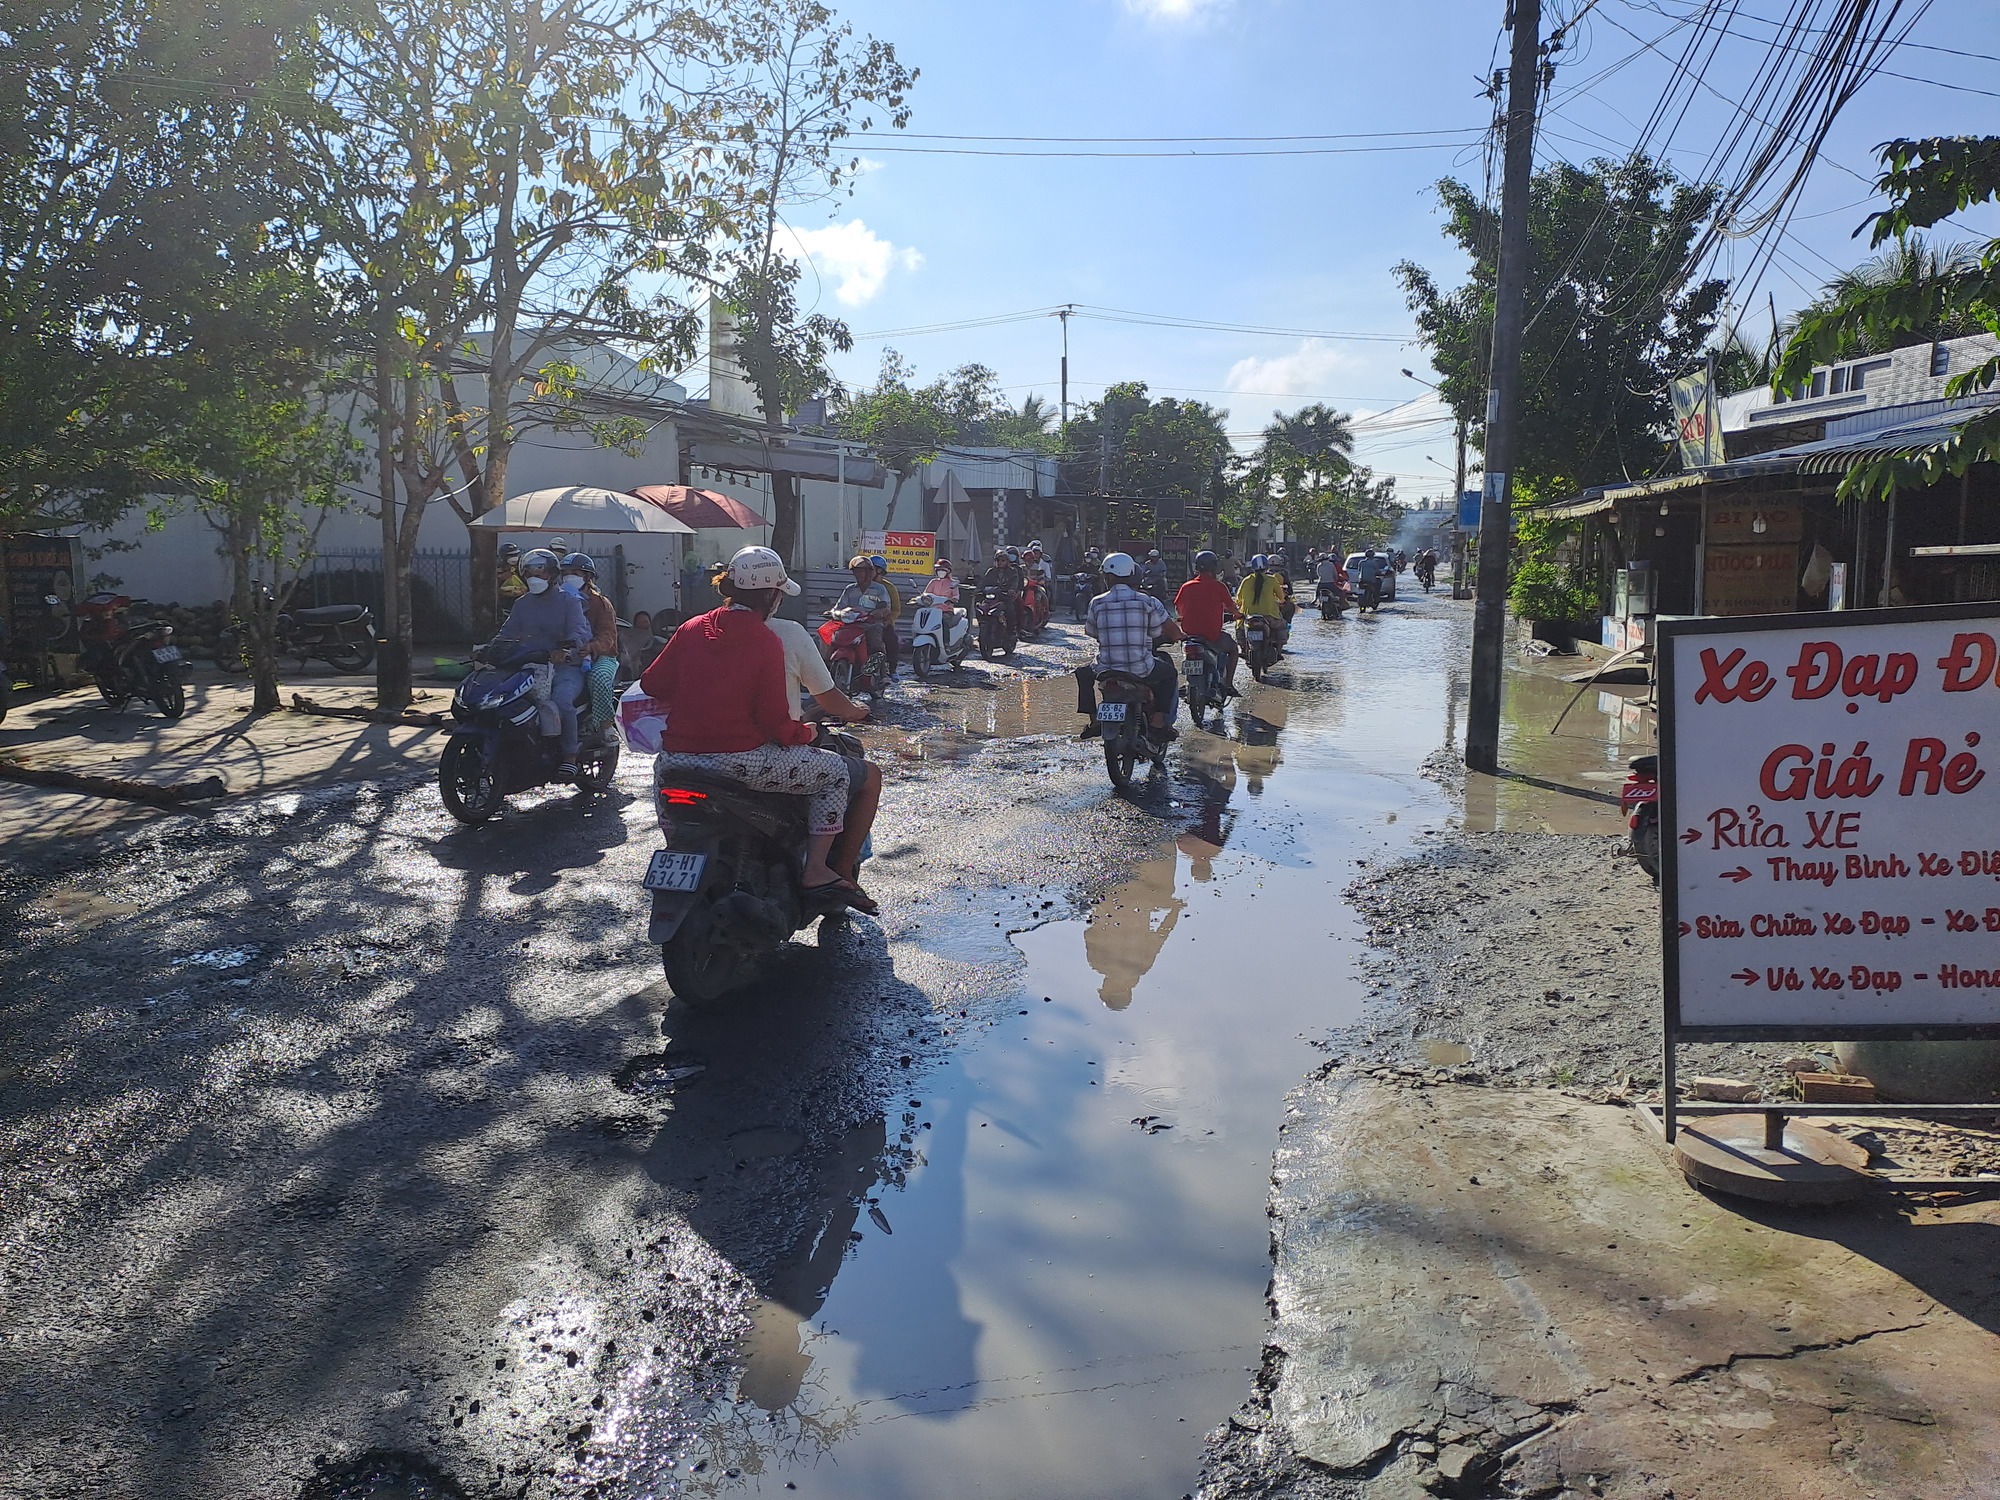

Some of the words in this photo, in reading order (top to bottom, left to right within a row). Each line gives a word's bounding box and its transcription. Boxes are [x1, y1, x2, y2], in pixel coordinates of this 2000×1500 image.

[1695, 647, 1777, 705] Xe
[1786, 641, 1918, 714] Đạp
[1937, 632, 2000, 692] Đ
[1760, 741, 1884, 801] Giá
[1898, 731, 1986, 796] Rẻ
[1707, 805, 1791, 850] Rửa
[1802, 810, 1861, 850] XE
[647, 870, 697, 889] 634.71
[658, 854, 697, 871] 95-H1
[1767, 856, 1839, 887] Thay
[1845, 853, 1911, 879] Bình
[1918, 852, 1954, 876] Xe
[1957, 850, 2000, 882] Điệ
[1750, 912, 1817, 937] Chữa
[1823, 912, 1856, 935] Xe
[1858, 911, 1910, 941] Đạp
[1945, 909, 1979, 932] Xe
[1982, 908, 2000, 932] Đ
[1767, 967, 1804, 991] Vá
[1811, 966, 1846, 990] Xe
[1848, 965, 1902, 996] Đạp
